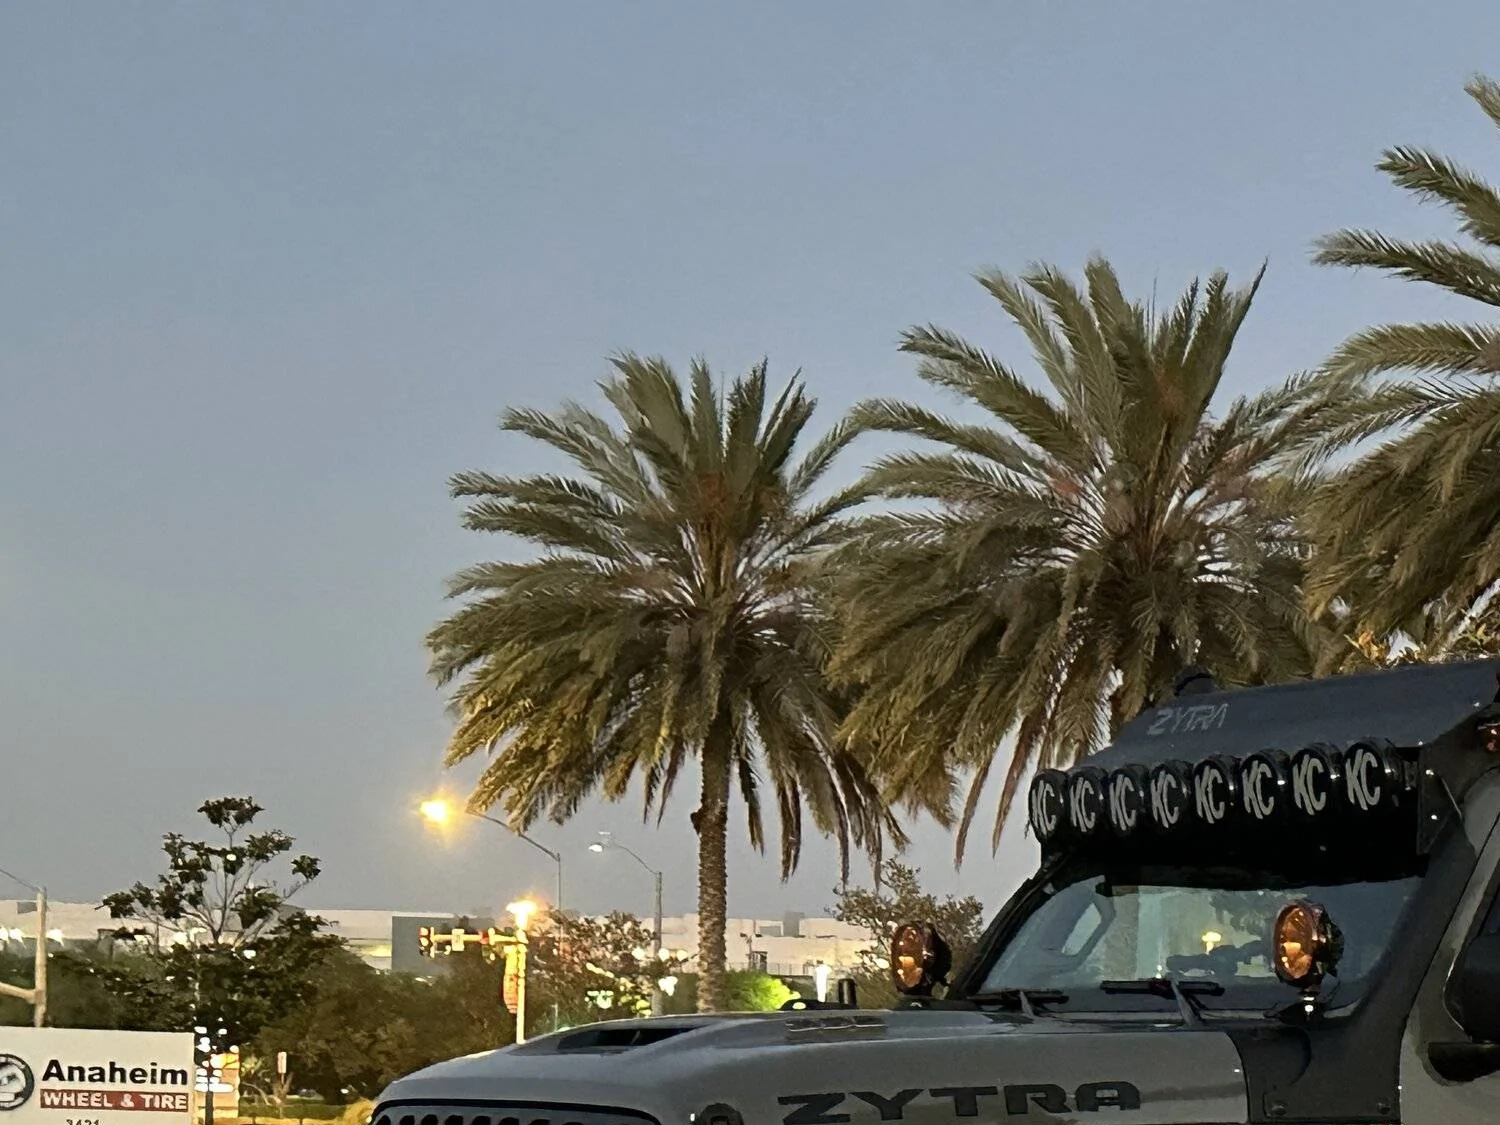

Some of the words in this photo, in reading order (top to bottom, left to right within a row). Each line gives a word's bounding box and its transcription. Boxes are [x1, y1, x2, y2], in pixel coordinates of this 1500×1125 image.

[1032, 780, 1057, 836] KC
[1070, 777, 1096, 832] KC
[1109, 774, 1136, 831] KC
[1151, 770, 1179, 829] KC
[1195, 765, 1225, 824] KC
[1242, 760, 1275, 820] KC
[1293, 754, 1327, 816] KC
[1345, 749, 1381, 811] KC
[42, 1059, 188, 1085] Anaheim
[43, 1091, 113, 1107] WHEEL
[120, 1095, 135, 1108] &
[139, 1094, 188, 1110] TIRE
[777, 1081, 1141, 1125] ZYTRA
